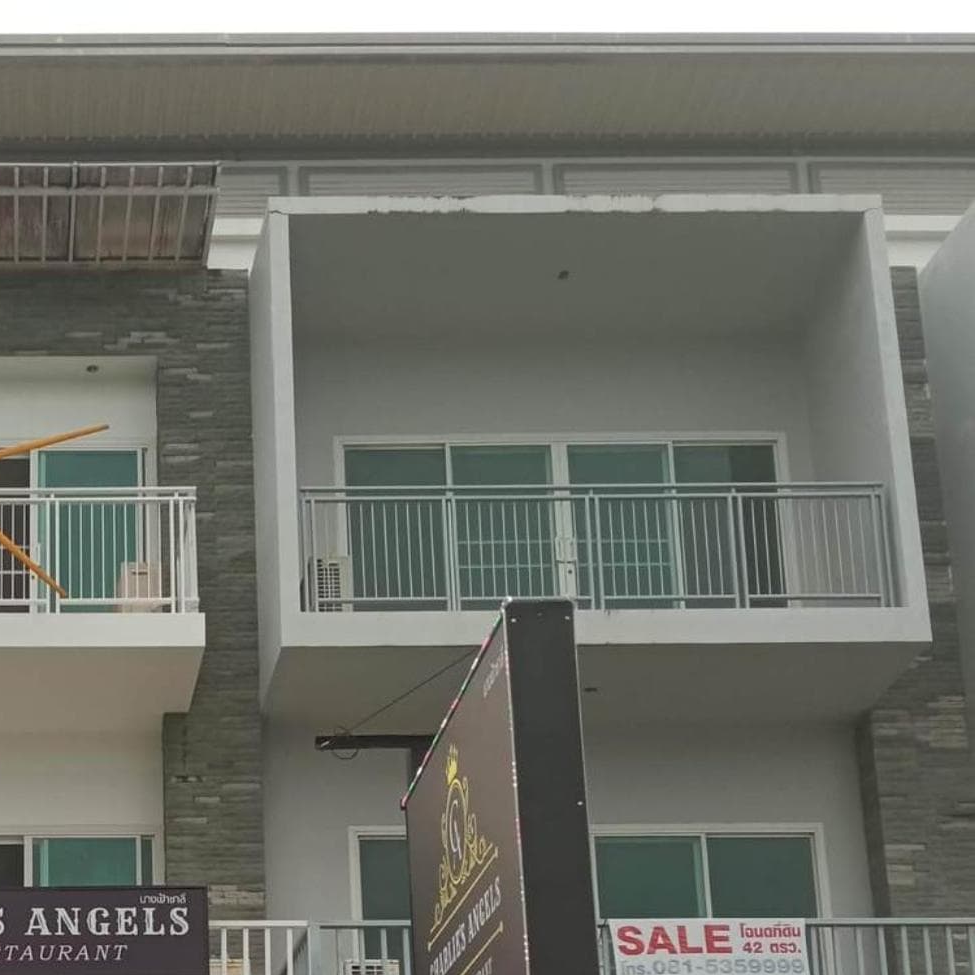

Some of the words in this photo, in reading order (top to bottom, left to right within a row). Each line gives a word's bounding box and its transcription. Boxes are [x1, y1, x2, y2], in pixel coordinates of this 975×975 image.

[26, 906, 190, 937] ANGELS
[467, 876, 501, 943] ANGELS
[617, 924, 733, 956] SALE
[742, 942, 764, 954] 42
